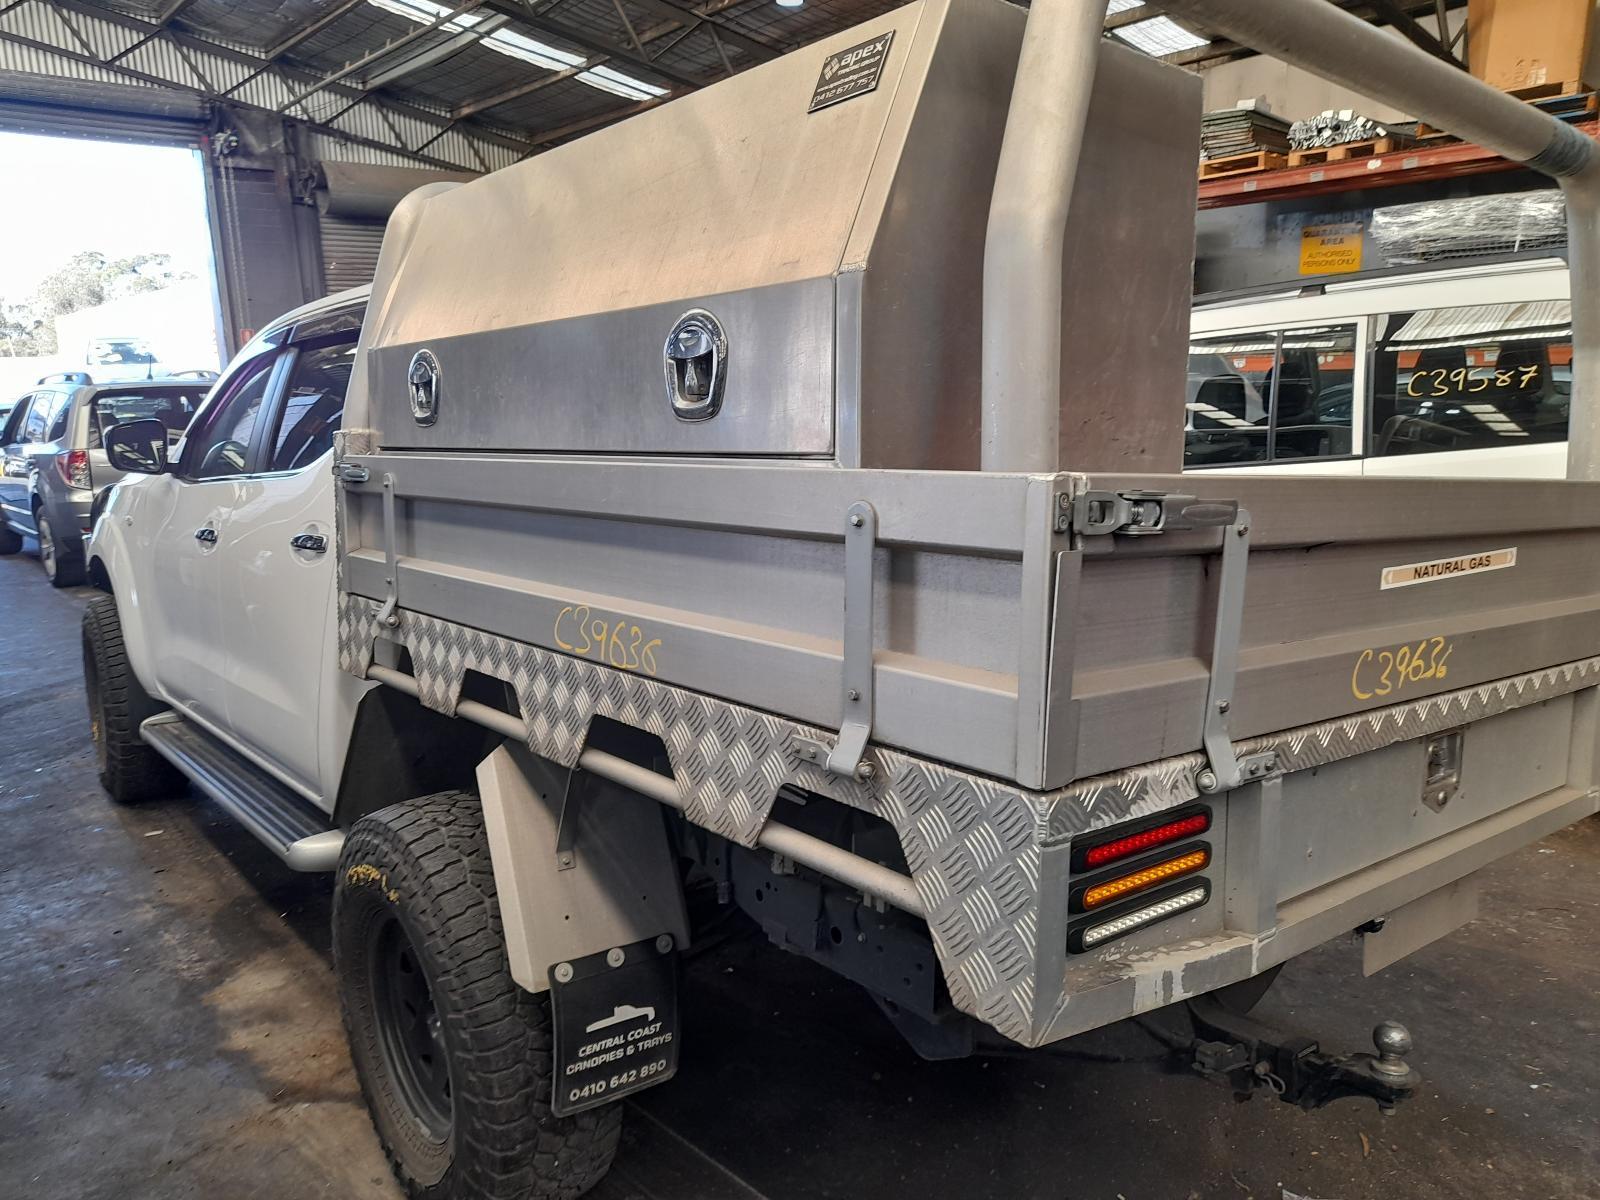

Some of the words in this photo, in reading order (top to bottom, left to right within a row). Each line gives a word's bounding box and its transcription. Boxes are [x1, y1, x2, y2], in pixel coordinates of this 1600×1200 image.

[841, 40, 886, 66] apex
[813, 90, 836, 104] 0412
[836, 82, 855, 95] 677
[856, 75, 875, 88] 757
[1407, 364, 1538, 397] C39587
[1413, 561, 1467, 580] NATURAL
[1469, 555, 1492, 570] GAS
[553, 605, 662, 677] C39636
[1352, 636, 1454, 700] C39636
[566, 1048, 625, 1076] CANOPIES
[626, 1045, 635, 1056] &
[637, 1032, 673, 1052] TRAYS
[578, 1034, 626, 1058] CENTRAL
[627, 1022, 662, 1041] COAST
[569, 1080, 606, 1102] 0410
[609, 1070, 637, 1089] 642
[640, 1059, 667, 1078] 890
